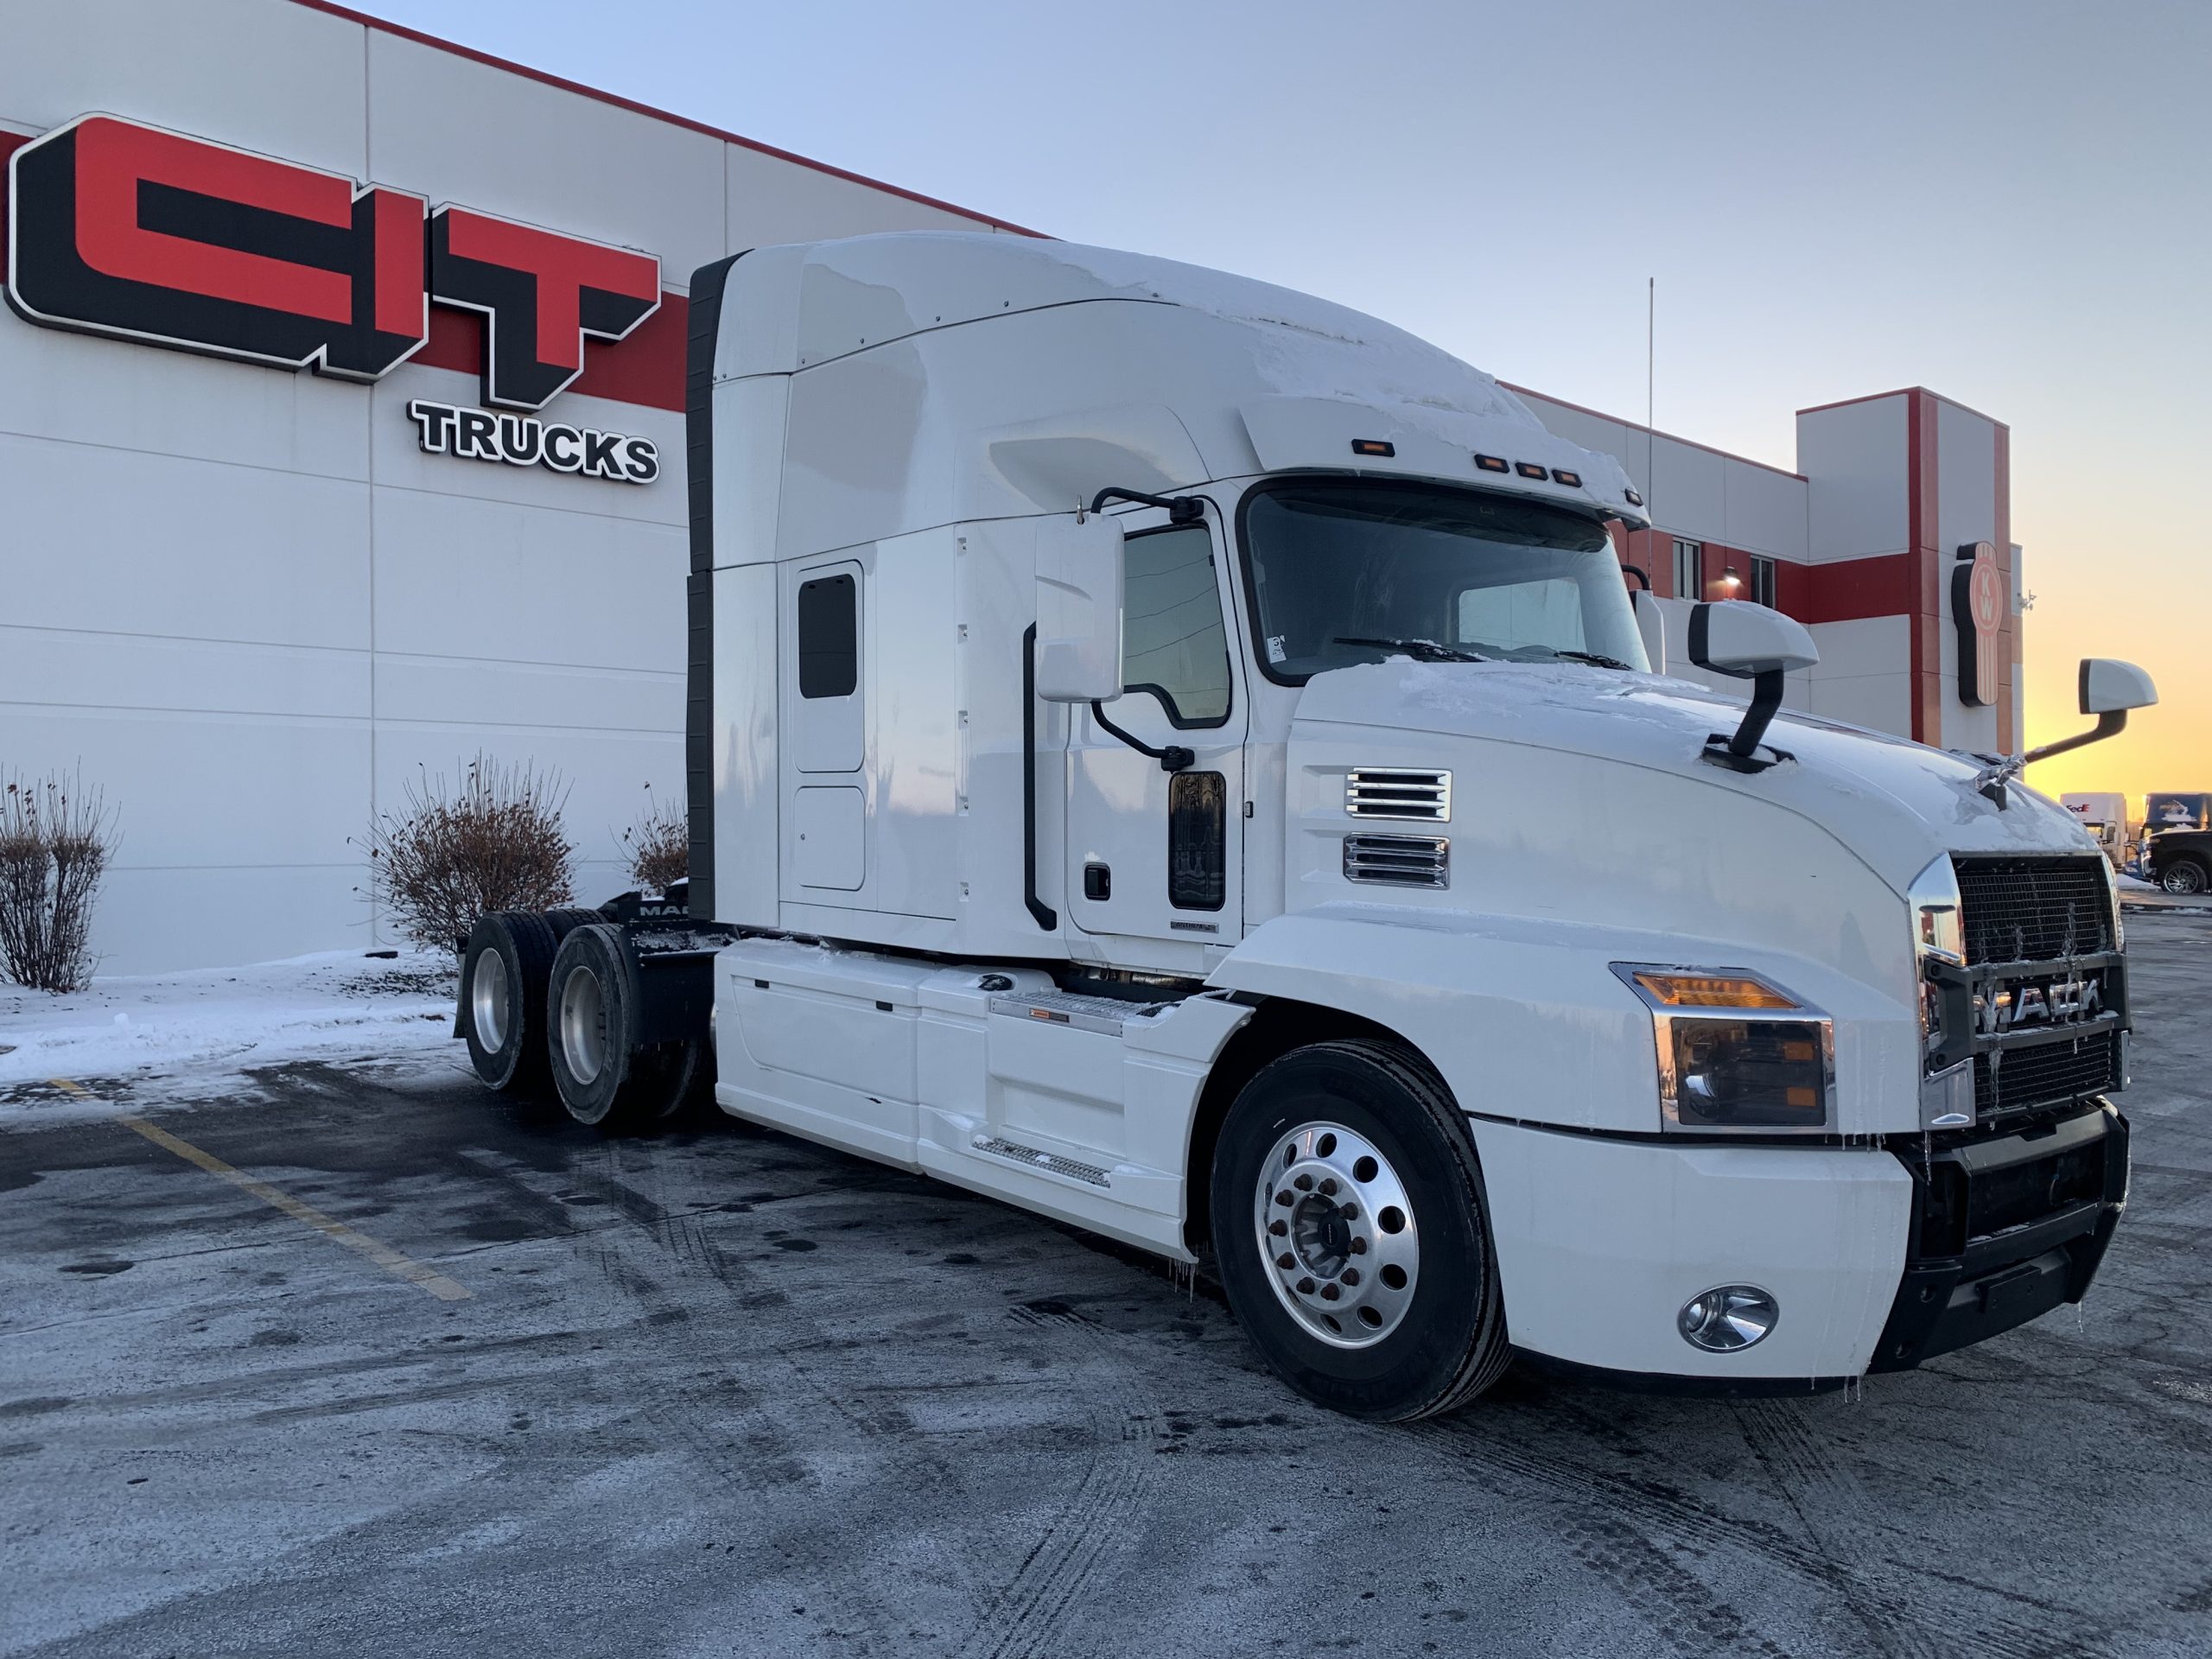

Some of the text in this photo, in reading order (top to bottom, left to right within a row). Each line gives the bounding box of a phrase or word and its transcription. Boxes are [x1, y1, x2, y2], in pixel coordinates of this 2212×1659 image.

[9, 111, 662, 412] CIT
[409, 400, 659, 484] TRUCKS
[1972, 978, 2103, 1033] MACK
